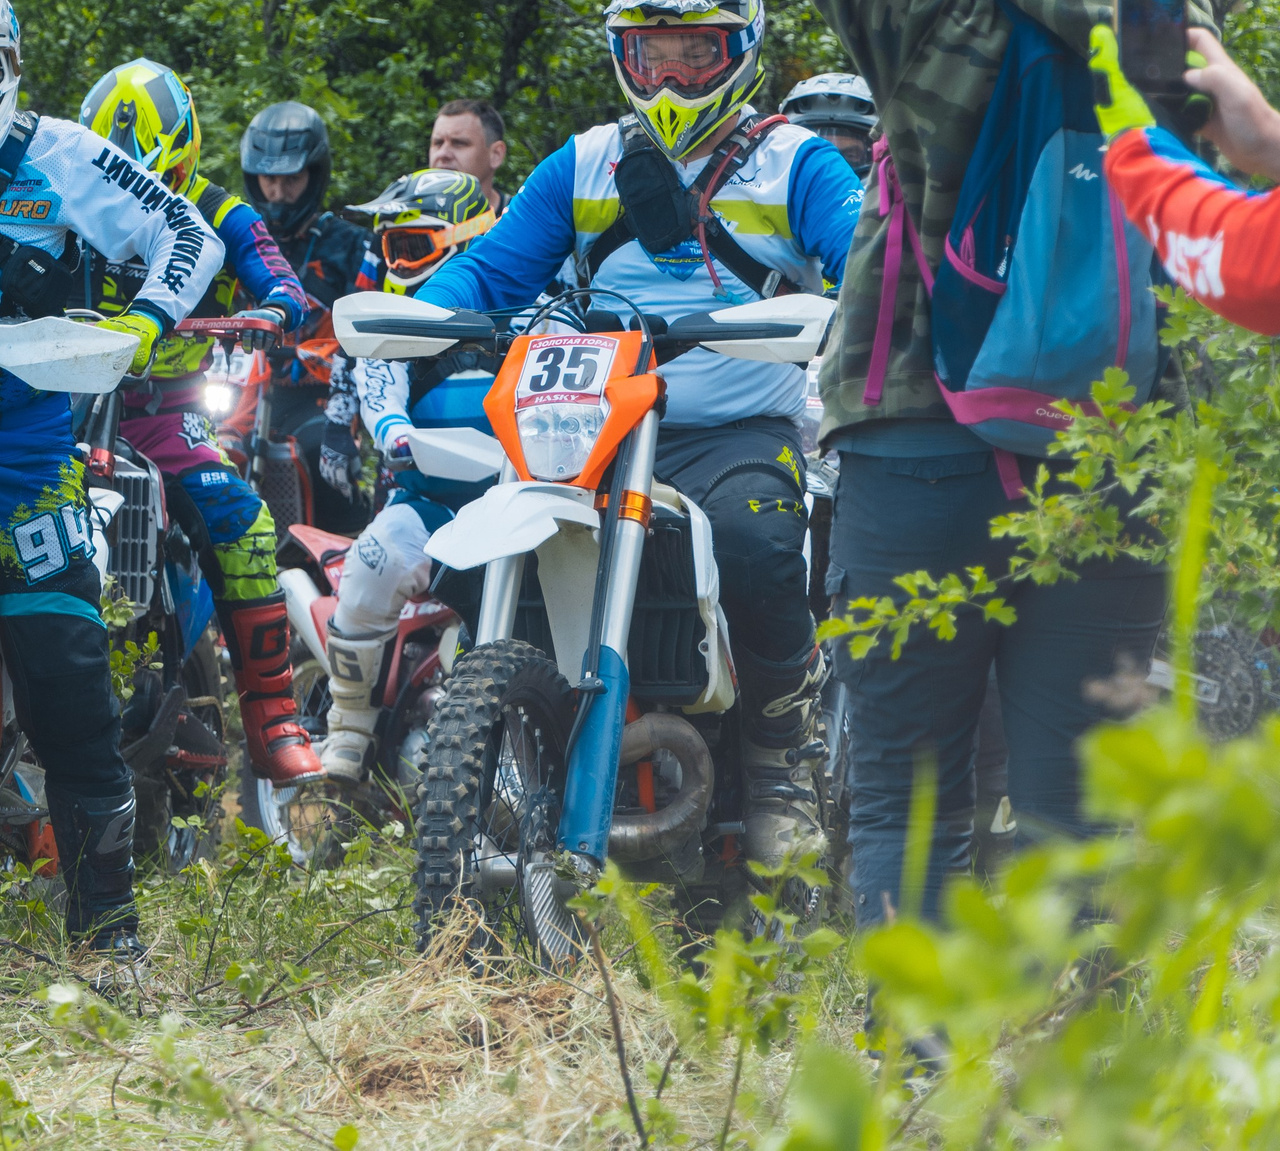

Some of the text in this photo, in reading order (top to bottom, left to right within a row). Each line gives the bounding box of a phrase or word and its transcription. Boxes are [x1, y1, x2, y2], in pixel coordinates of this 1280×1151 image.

[533, 338, 614, 349] «ЗОЛОТАЯ ГОРА»
[529, 346, 600, 392] 35
[534, 394, 579, 403] HASKY
[201, 472, 228, 483] BSE
[11, 500, 96, 586] 94
